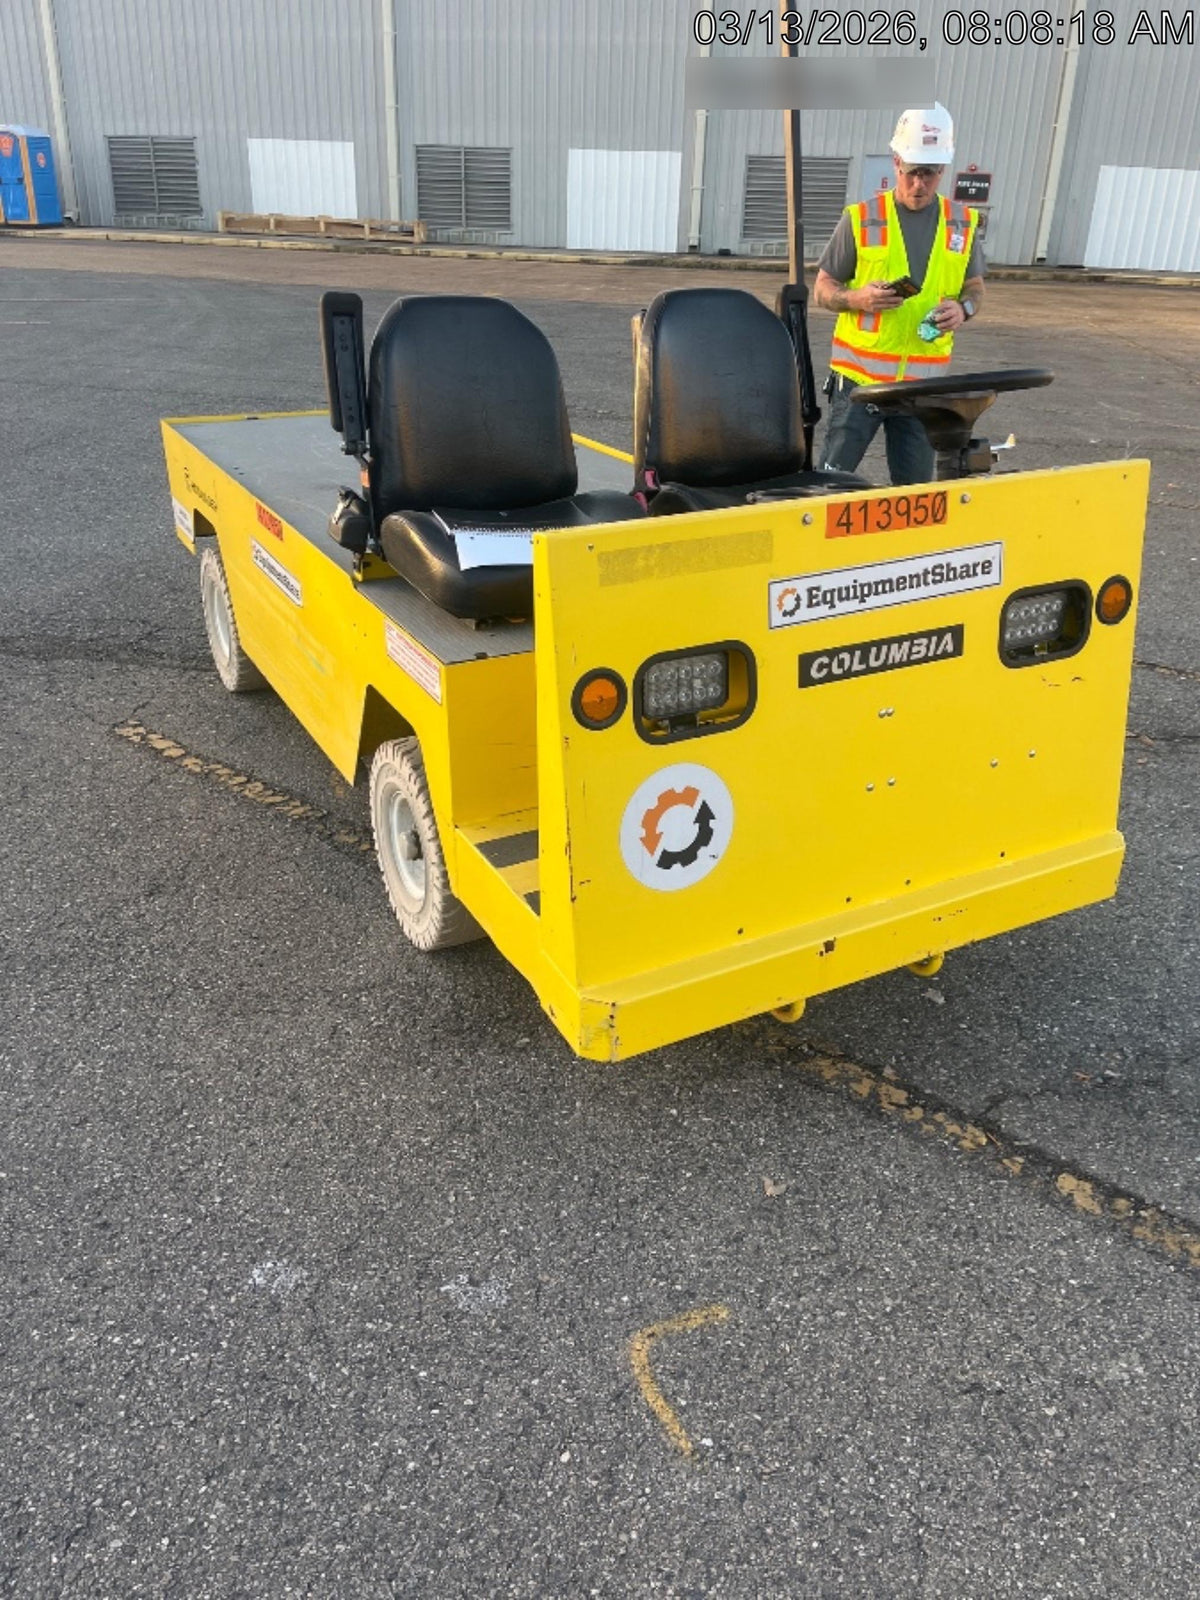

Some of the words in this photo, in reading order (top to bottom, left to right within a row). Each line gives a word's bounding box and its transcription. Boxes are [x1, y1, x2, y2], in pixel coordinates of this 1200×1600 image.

[835, 490, 948, 534] 413950
[806, 558, 993, 610] EquipmentShare
[809, 632, 955, 680] COLUMBIA
